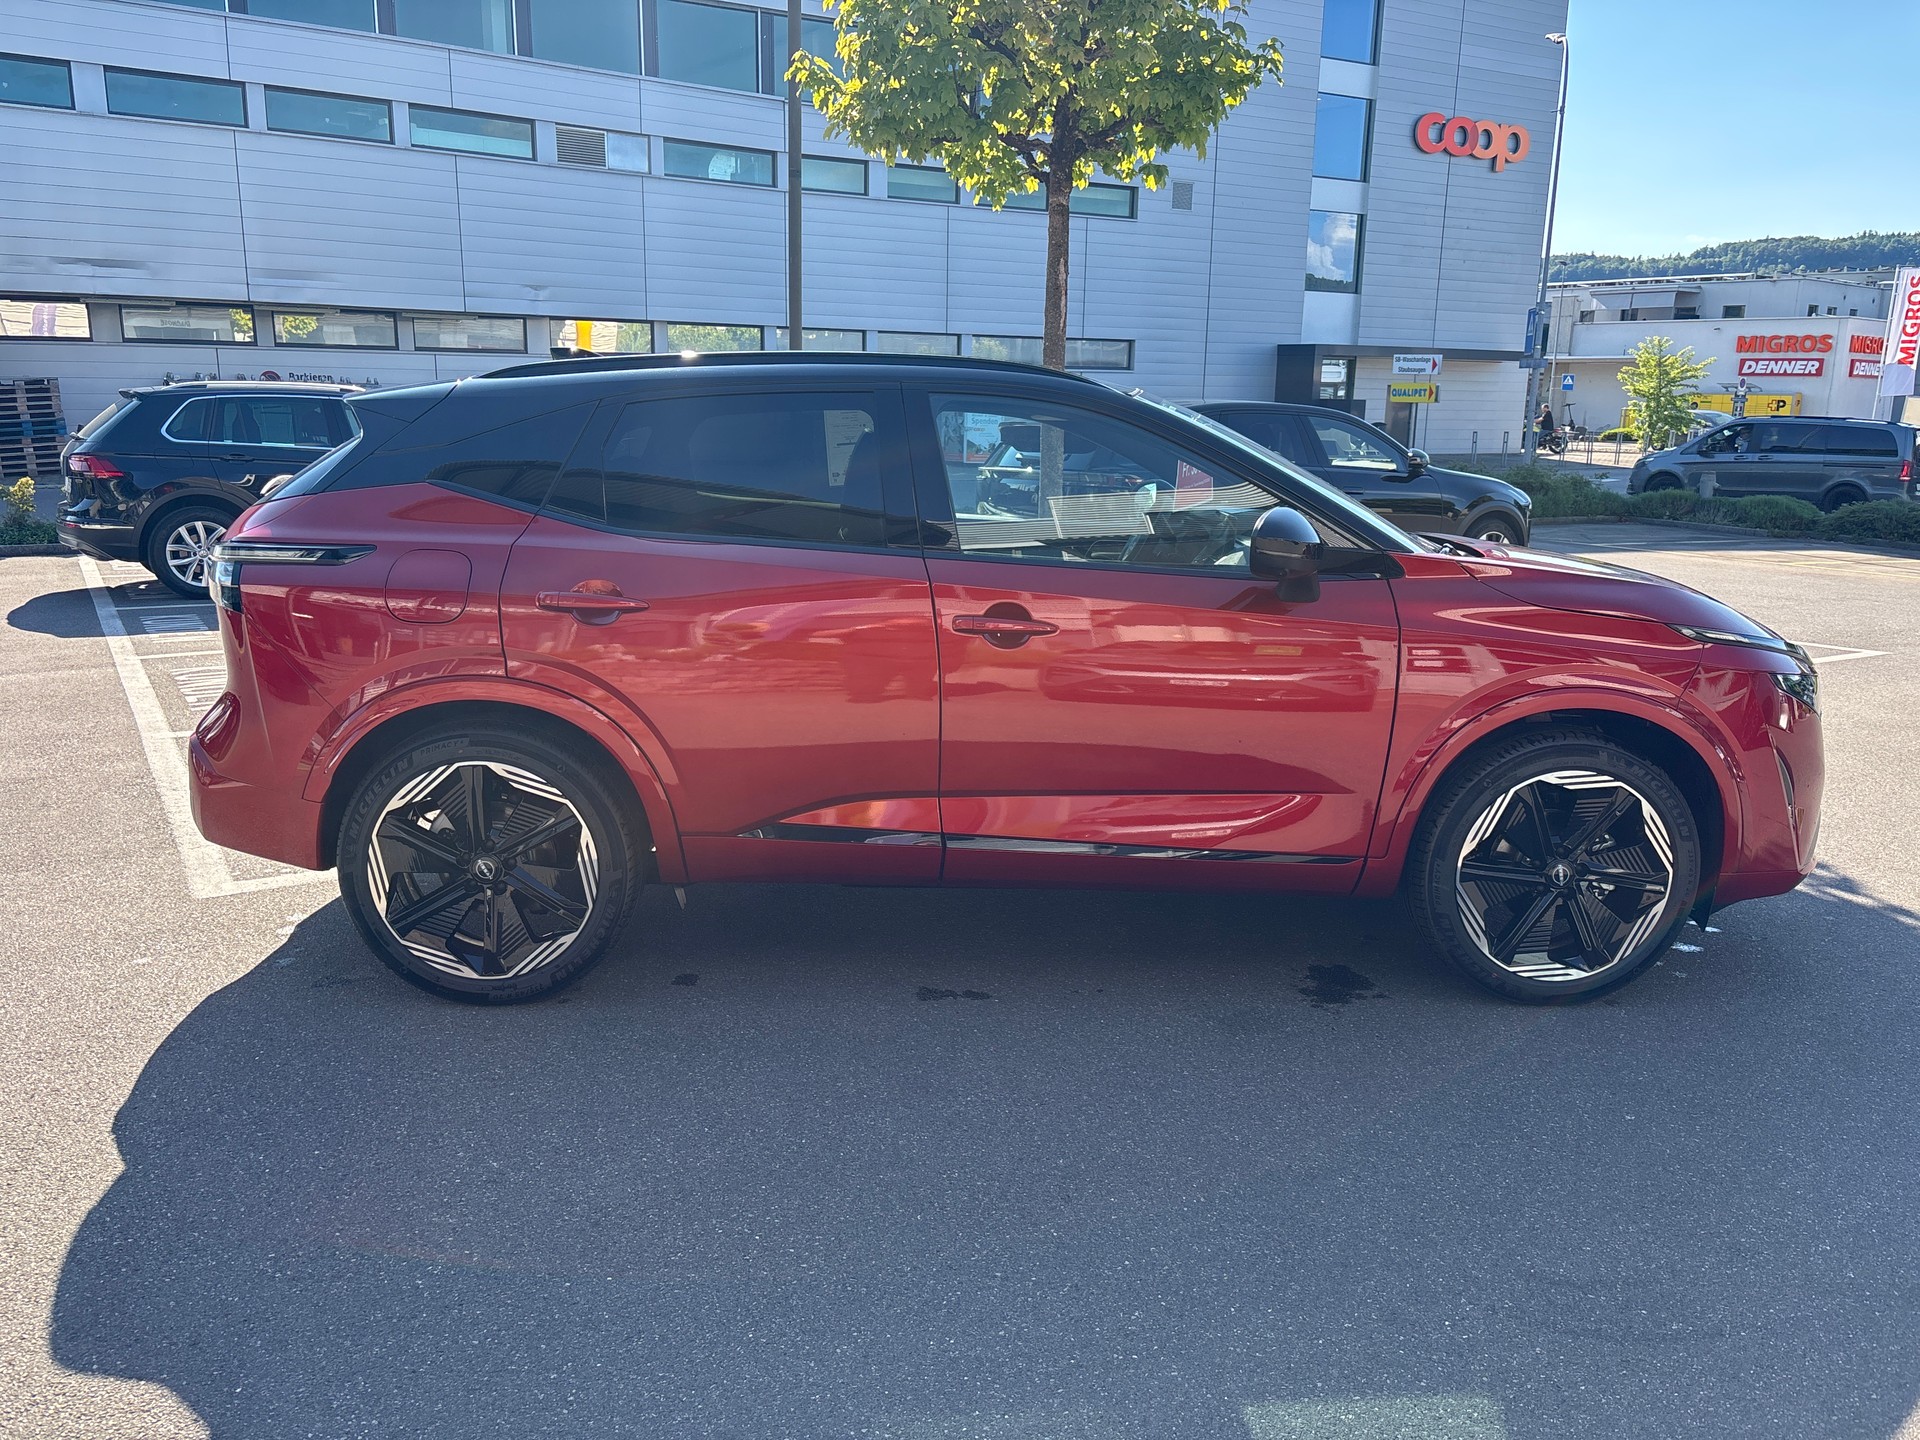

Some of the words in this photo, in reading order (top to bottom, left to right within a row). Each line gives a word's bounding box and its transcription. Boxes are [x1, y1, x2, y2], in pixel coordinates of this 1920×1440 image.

[1415, 112, 1530, 173] coop
[1898, 276, 1920, 365] MIGROS
[1736, 334, 1833, 353] MIGROS
[1849, 335, 1884, 354] MIGRO
[1741, 360, 1820, 374] DENNER
[1853, 361, 1882, 375] DENNE
[1391, 388, 1428, 398] QUALIPET
[971, 417, 999, 426] Spenden
[420, 740, 458, 755] PRIMACY
[349, 756, 410, 840] MICHELIN
[1631, 764, 1690, 838] MICHELIN
